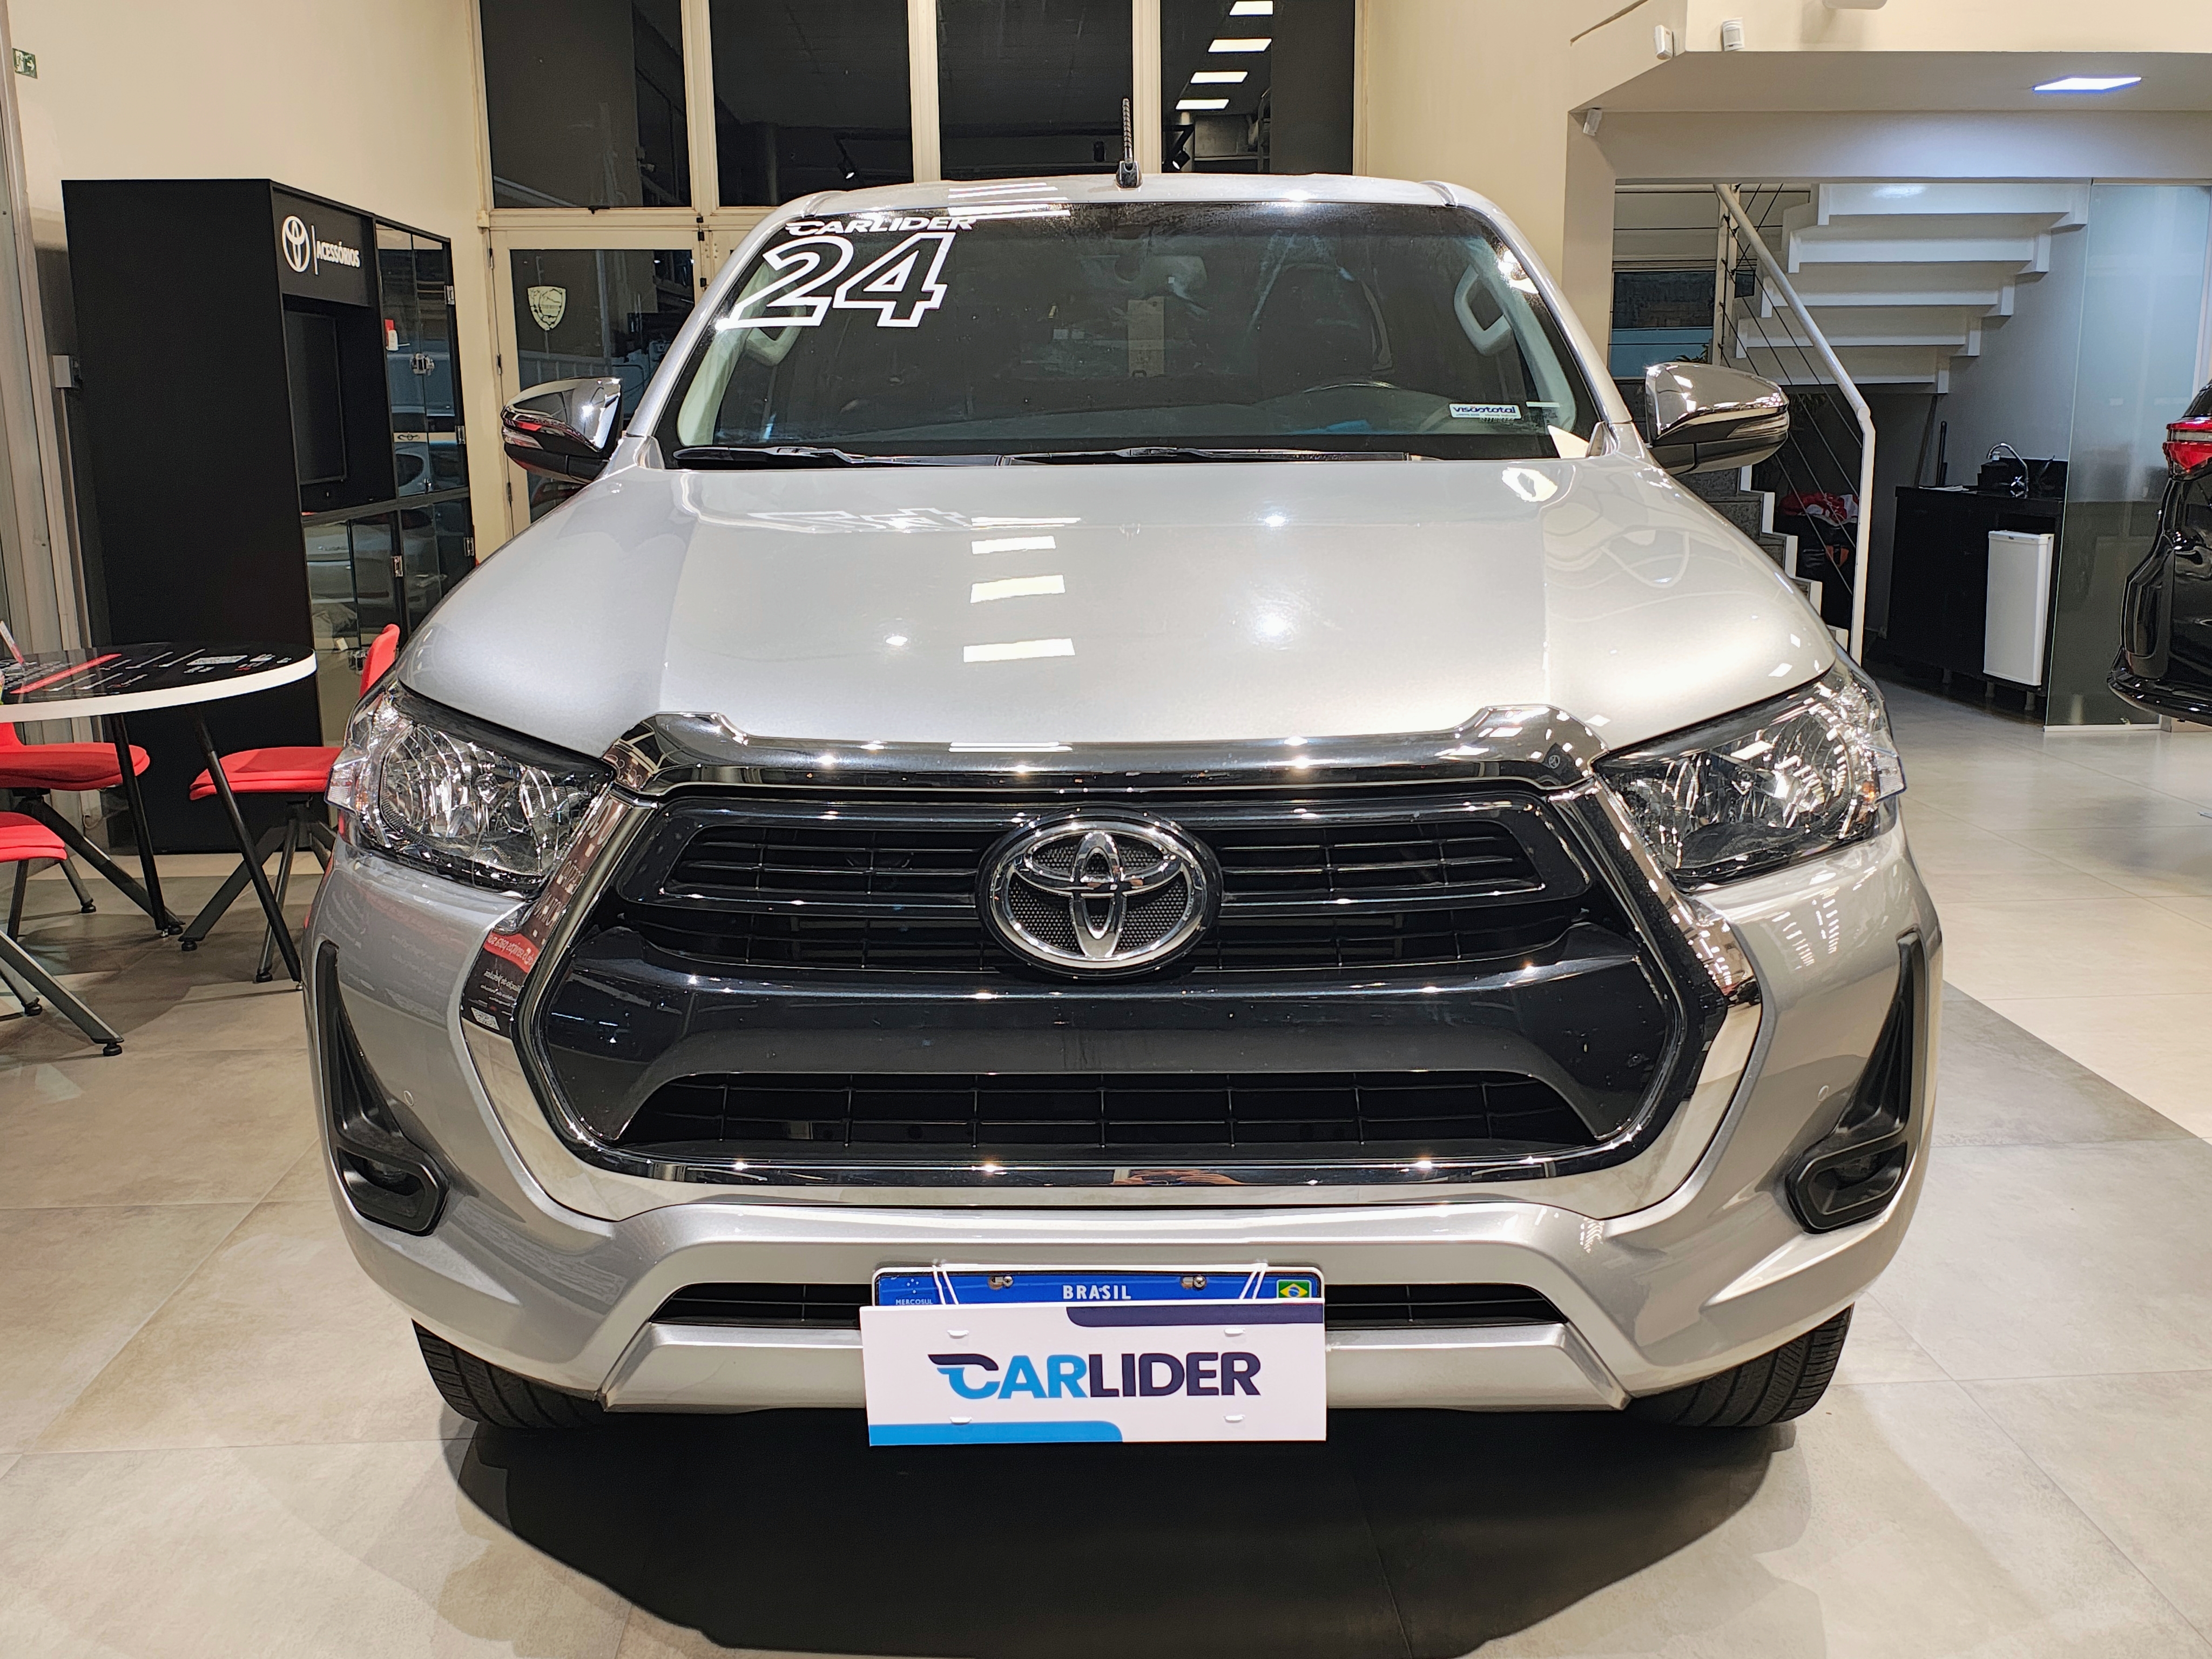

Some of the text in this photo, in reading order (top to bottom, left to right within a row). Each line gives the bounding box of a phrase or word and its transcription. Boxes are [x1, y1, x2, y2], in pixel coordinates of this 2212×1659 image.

[785, 217, 976, 236] CARLIDER
[316, 240, 361, 268] ACESSÓRIOS
[716, 232, 956, 328] 24
[1062, 1284, 1132, 1300] BRASIL
[927, 1351, 1262, 1400] CARLIDER
